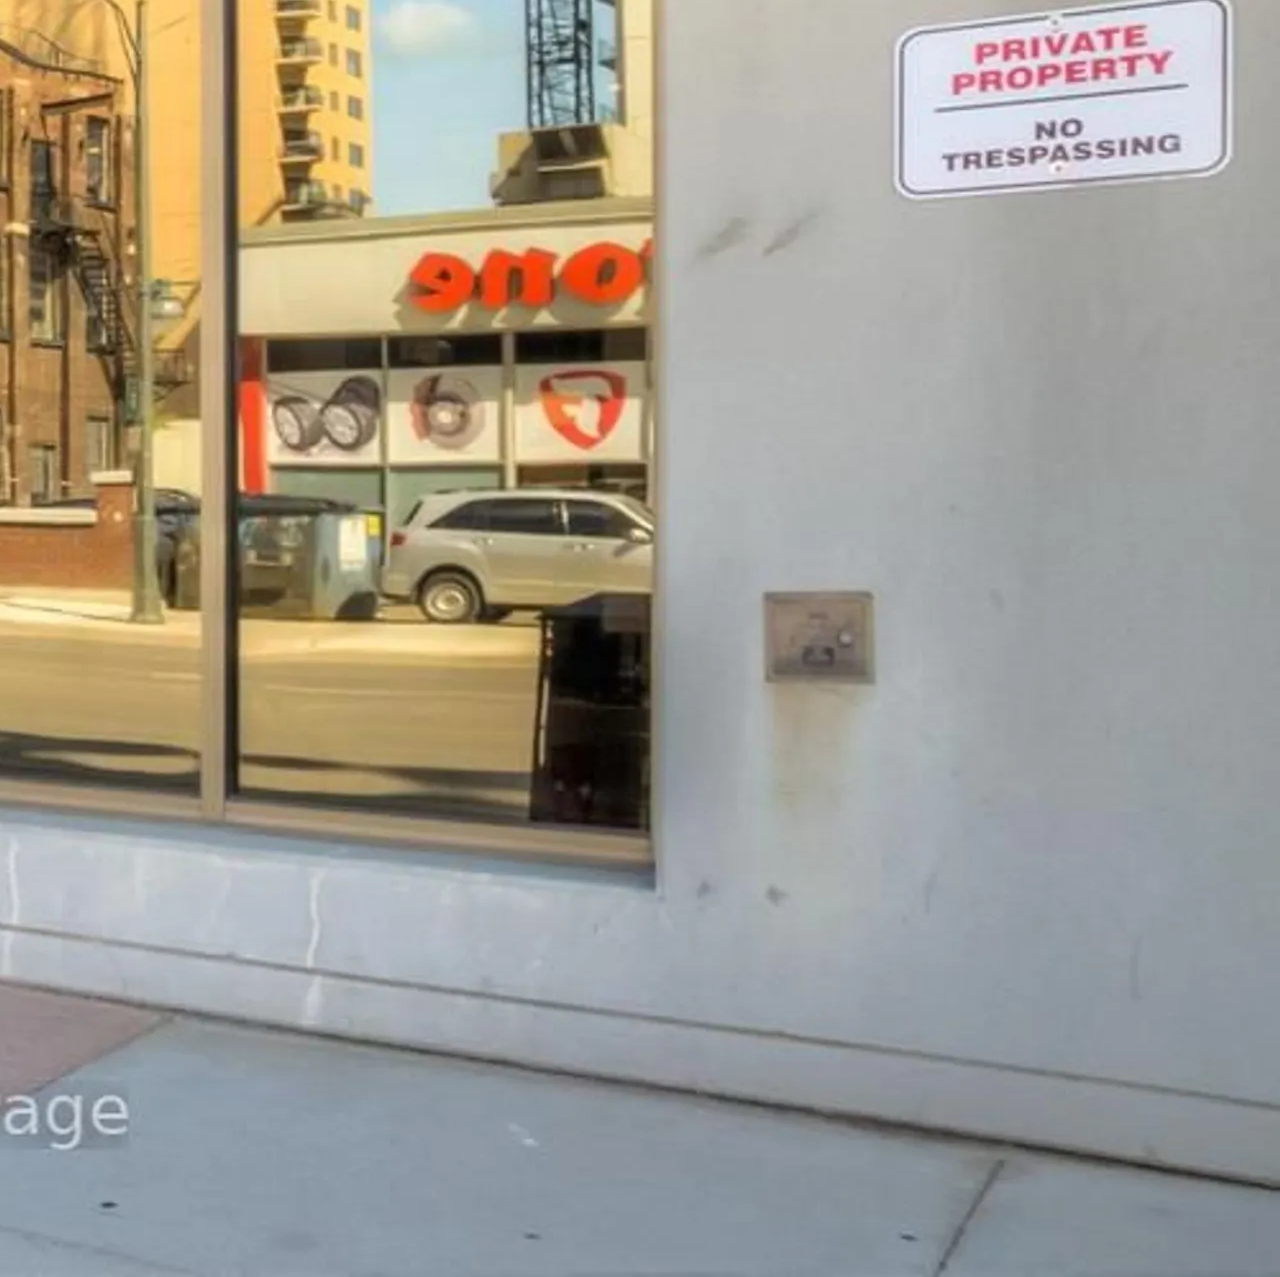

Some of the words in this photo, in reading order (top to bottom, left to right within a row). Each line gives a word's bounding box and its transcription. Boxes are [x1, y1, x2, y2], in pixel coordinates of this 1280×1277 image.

[974, 25, 1148, 65] PRIVATE
[951, 50, 1174, 96] PROPERTY
[1034, 118, 1084, 141] NO
[941, 133, 1182, 172] TRESPASSING
